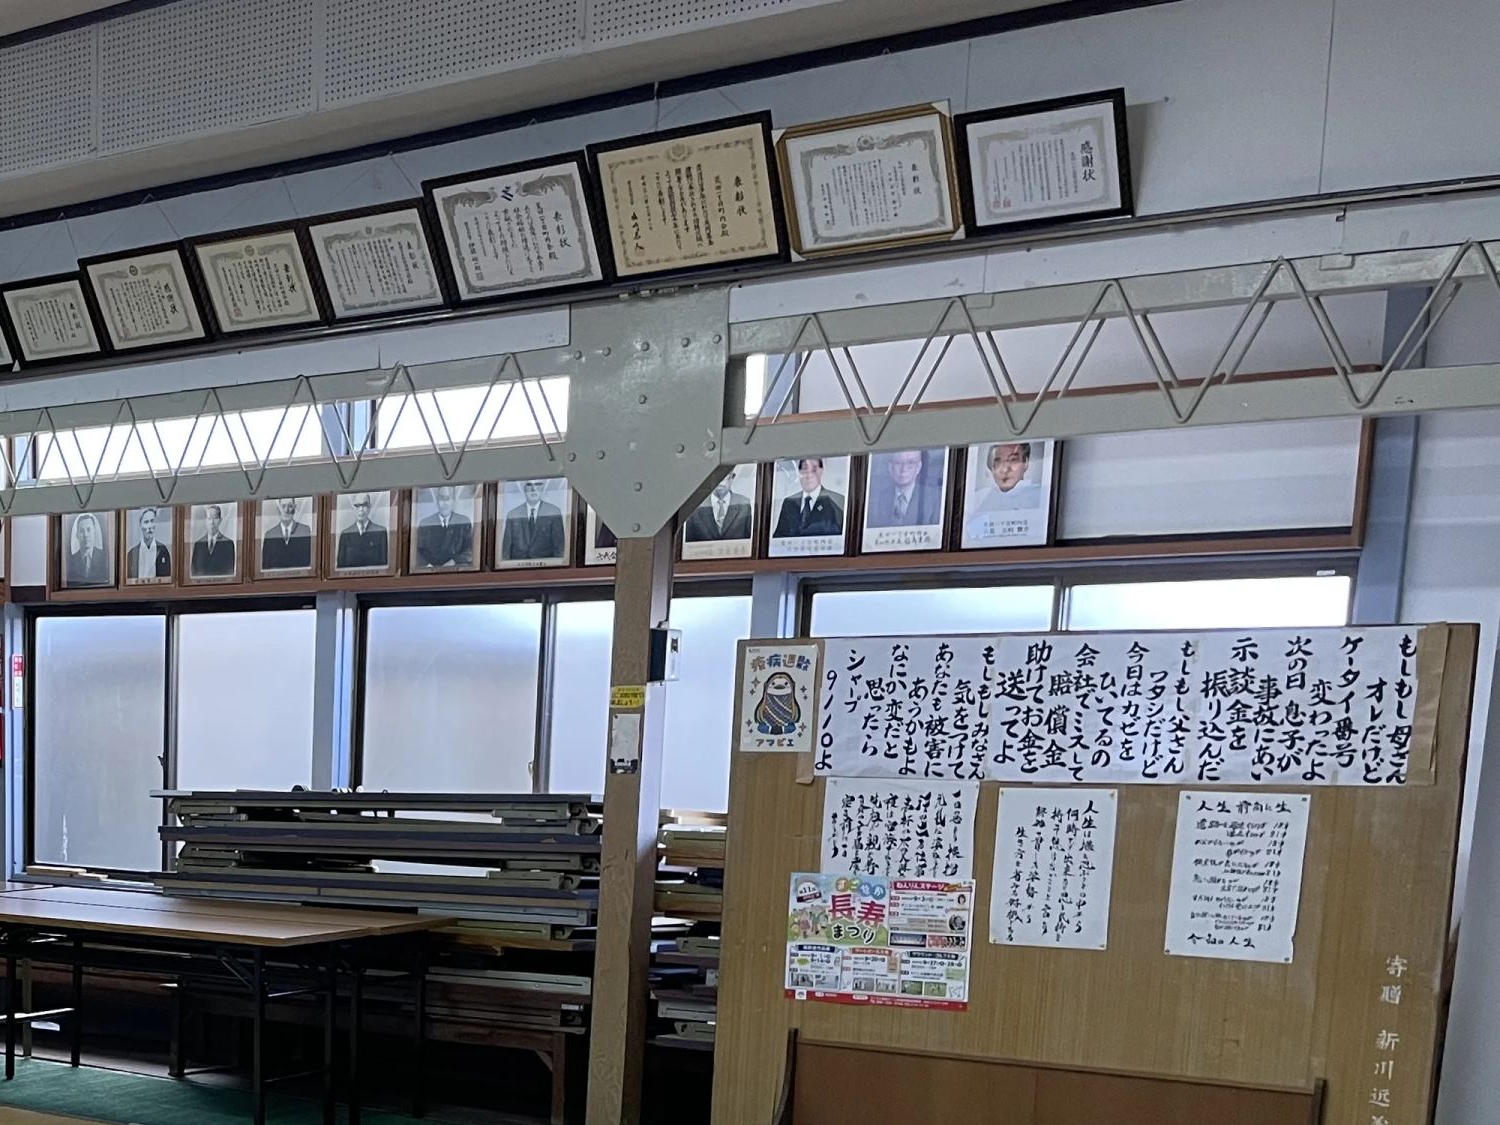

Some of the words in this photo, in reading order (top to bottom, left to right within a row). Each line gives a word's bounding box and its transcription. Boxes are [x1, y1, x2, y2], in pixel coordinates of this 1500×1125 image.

[734, 175, 747, 216] 表彰状
[1080, 141, 1096, 182] 感謝状
[554, 211, 571, 249] 表彰状
[750, 654, 811, 672] 疫病退散
[844, 649, 866, 714] シャープ
[884, 644, 910, 759] なにか変だと
[924, 642, 954, 777] あなたも被害に
[968, 645, 995, 780] もしもしみなさん
[1017, 639, 1053, 773] 助けてお金を
[1067, 642, 1100, 782] 会社でミスして
[1119, 641, 1150, 761] 今日はカゼを
[1164, 640, 1196, 774] もしもし父さん
[1226, 637, 1259, 750] 示談金を
[1330, 635, 1364, 767] ケータイ番号
[1385, 634, 1417, 783] もしもし母さん
[756, 738, 795, 747] アマビエ
[862, 677, 885, 756] 思ったら
[898, 677, 929, 775] あうかもよ
[947, 679, 975, 779] 気をつけて
[993, 668, 1028, 764] 送ってよ
[1040, 670, 1074, 769] 賠償金
[1091, 671, 1118, 767] ひいてるの
[1142, 671, 1169, 778] ワタシだけど
[1197, 671, 1228, 780] 振り込んだ
[1251, 674, 1283, 781] 事故にあい
[1302, 679, 1336, 780] 変わったよ
[1362, 678, 1387, 783] オレだけど
[828, 893, 886, 928] 長寿
[833, 924, 875, 943] まつり
[838, 879, 884, 898] すこやか
[1380, 955, 1408, 1005] 寄贈
